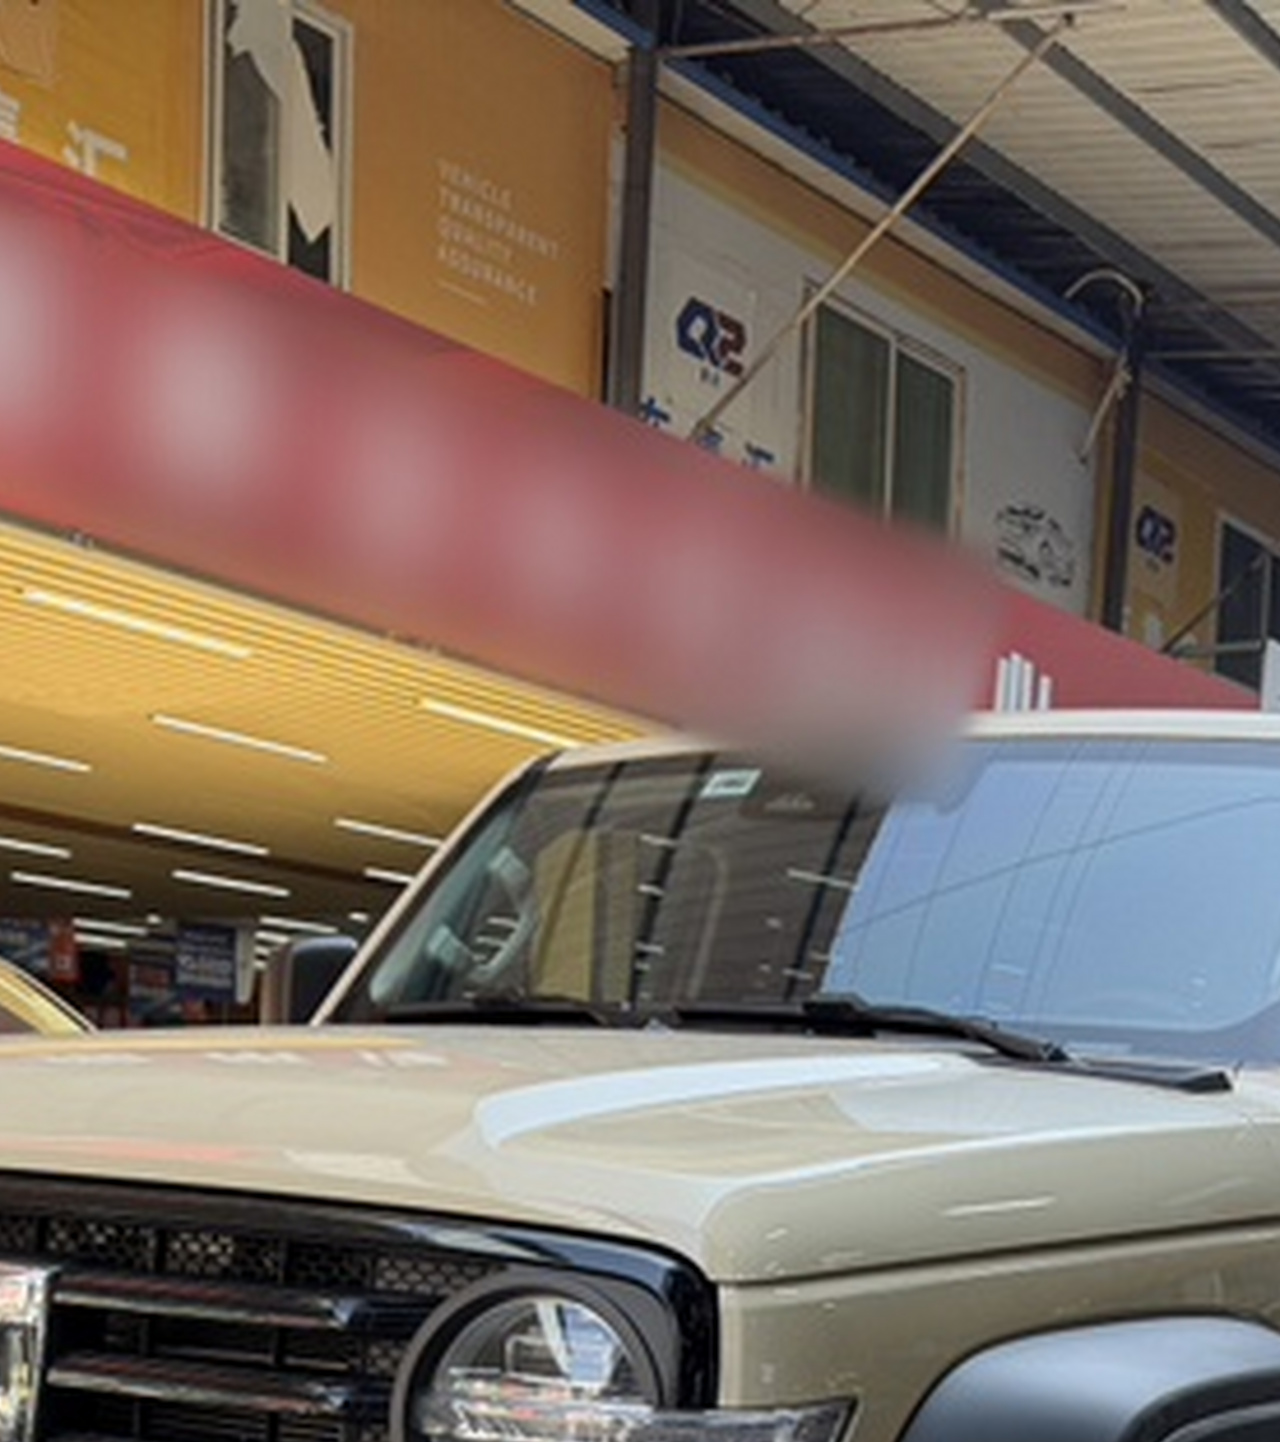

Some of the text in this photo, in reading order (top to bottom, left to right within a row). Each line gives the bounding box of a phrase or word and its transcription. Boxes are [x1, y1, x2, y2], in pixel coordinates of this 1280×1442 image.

[436, 158, 512, 211] VEHICLE
[437, 214, 513, 266] QUALITY
[438, 185, 559, 261] TRANSPARENT
[437, 242, 537, 306] ASSURANCE
